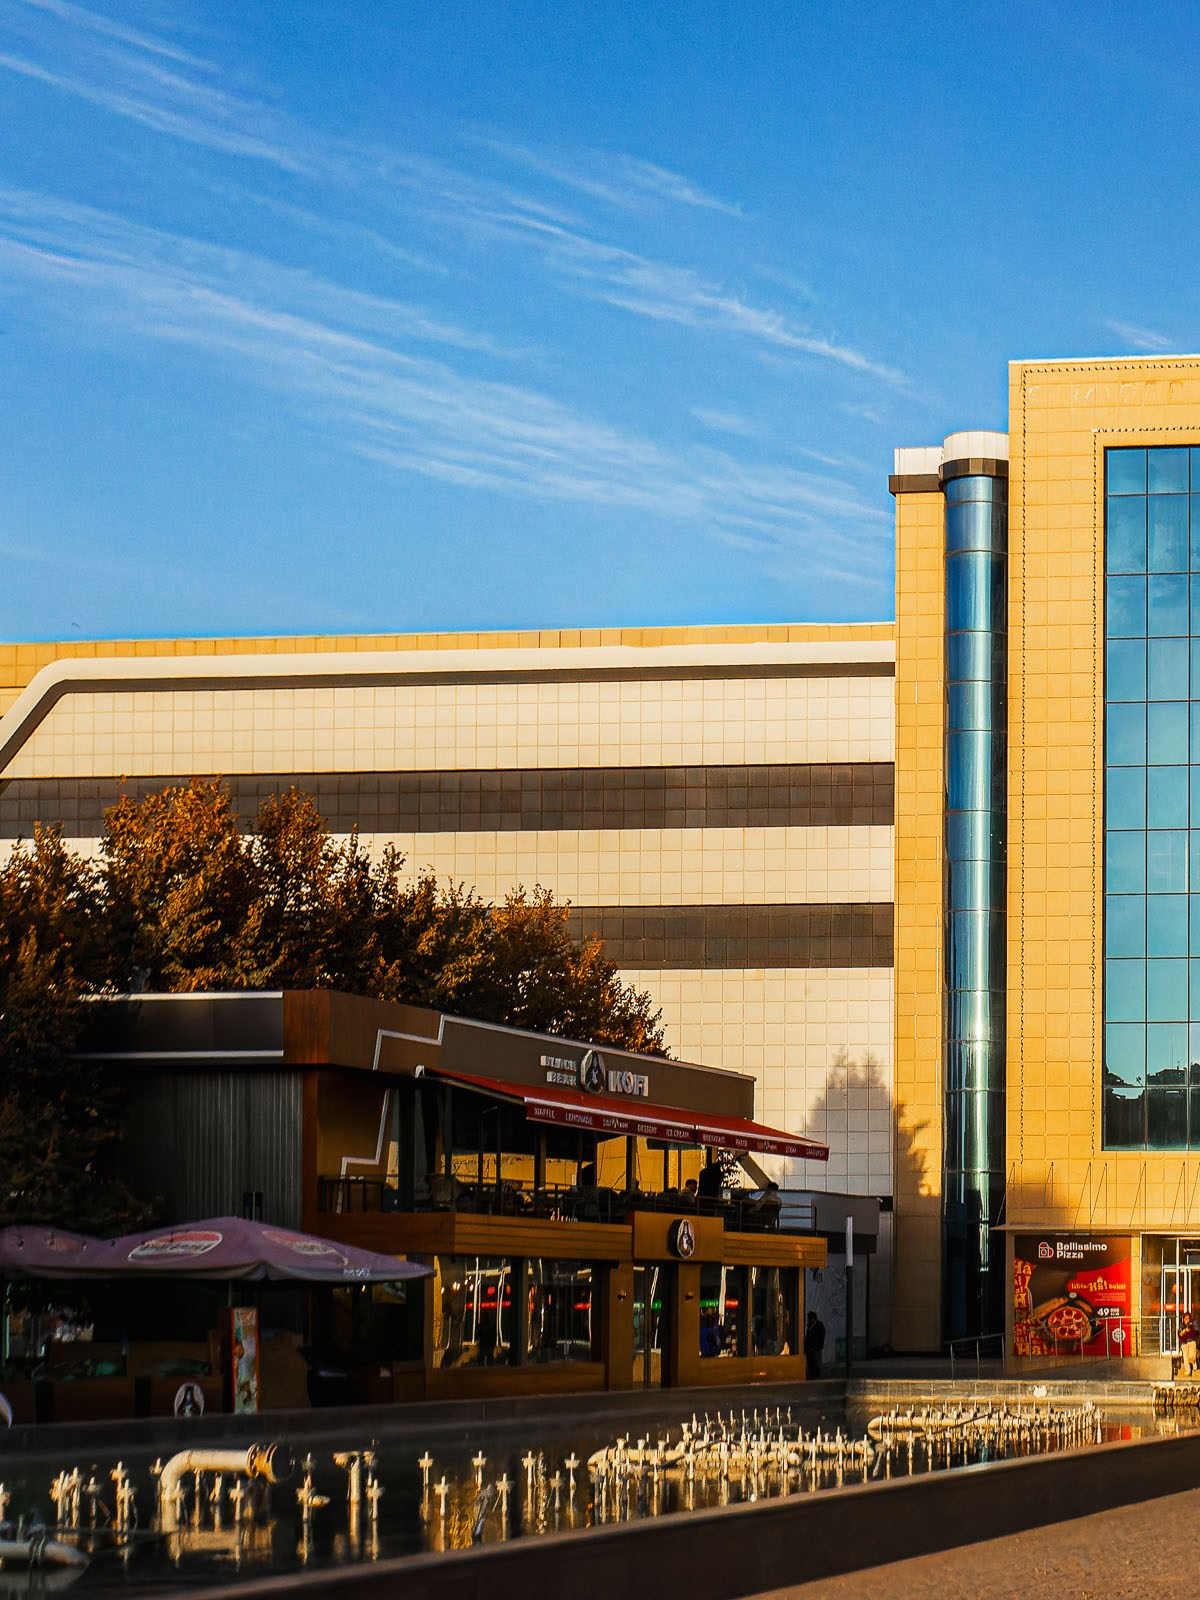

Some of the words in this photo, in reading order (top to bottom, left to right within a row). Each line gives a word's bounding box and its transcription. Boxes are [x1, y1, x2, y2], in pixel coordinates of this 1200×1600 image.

[1056, 1242, 1108, 1251] Bellissimo
[1056, 1251, 1084, 1259] Pizza
[1097, 1307, 1110, 1317] 49
